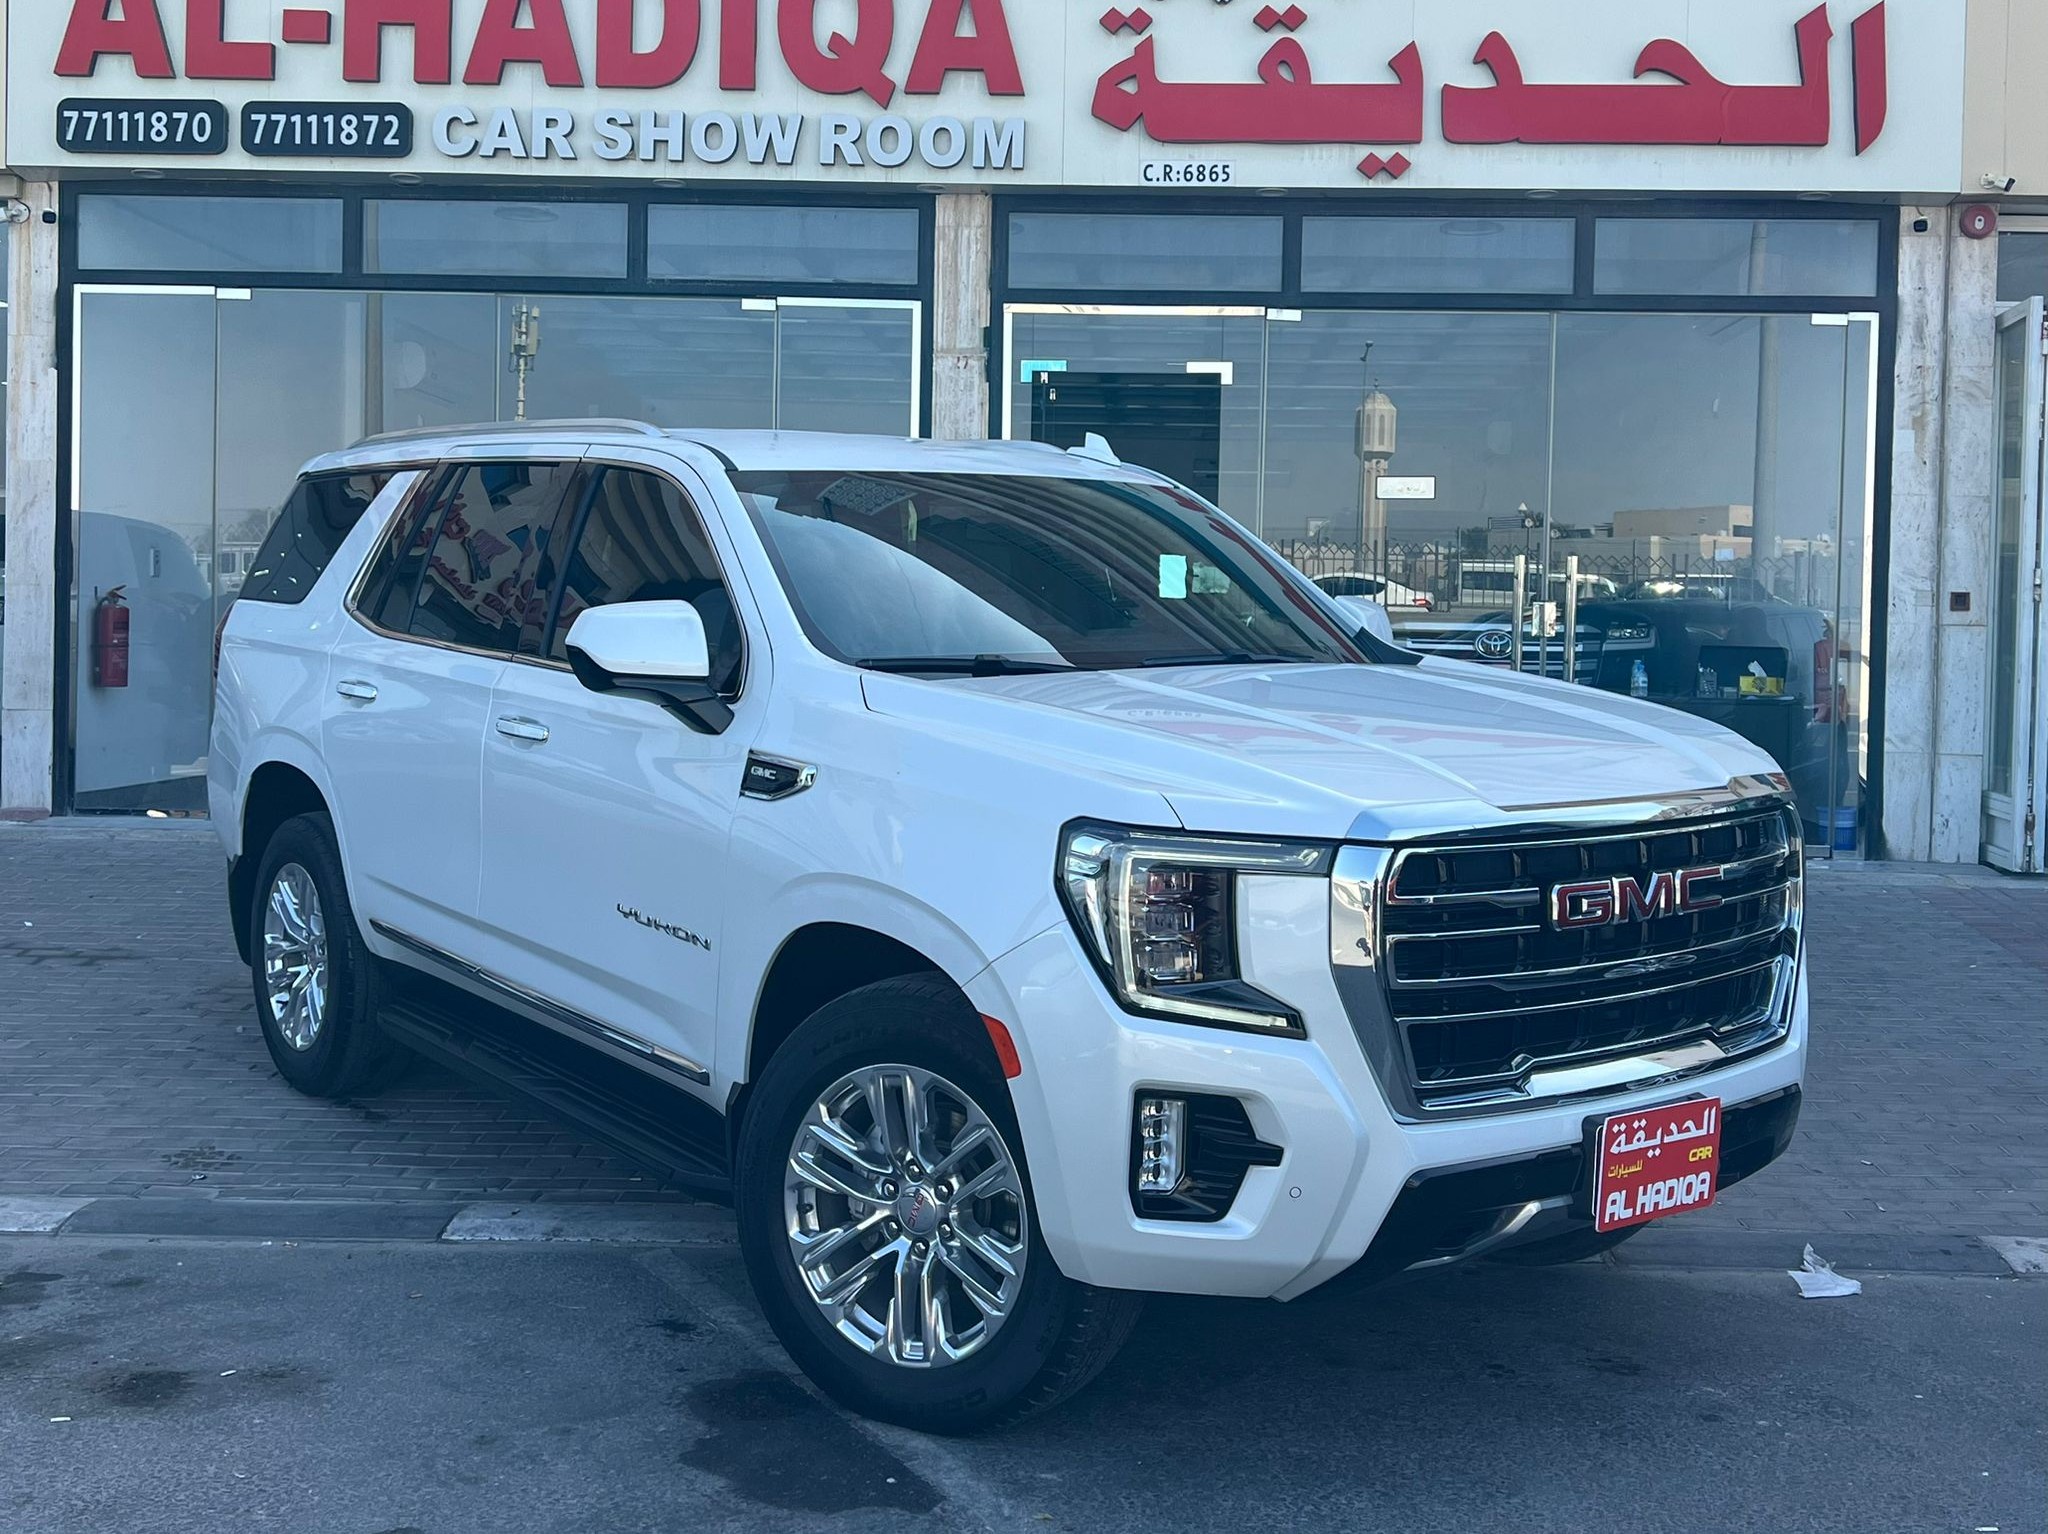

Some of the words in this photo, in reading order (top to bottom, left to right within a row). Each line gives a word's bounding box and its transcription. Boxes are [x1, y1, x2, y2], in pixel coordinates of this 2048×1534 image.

[1091, 0, 1888, 182] الحديقة
[62, 109, 212, 144] 77111870
[250, 113, 400, 147] 77111872
[432, 106, 576, 161] CAR
[592, 108, 803, 165] SHOW
[820, 112, 1025, 171] ROOM
[1143, 164, 1231, 182] C.R:6865
[750, 765, 777, 780] GMC
[1550, 865, 1726, 931] GMC
[616, 902, 712, 951] YUKON
[1609, 1106, 1717, 1159] الحديقة
[1688, 1145, 1713, 1162] CAR
[1607, 1159, 1643, 1179] للسيارات
[1604, 1189, 1634, 1224] AL
[1635, 1170, 1711, 1216] HADIQA
